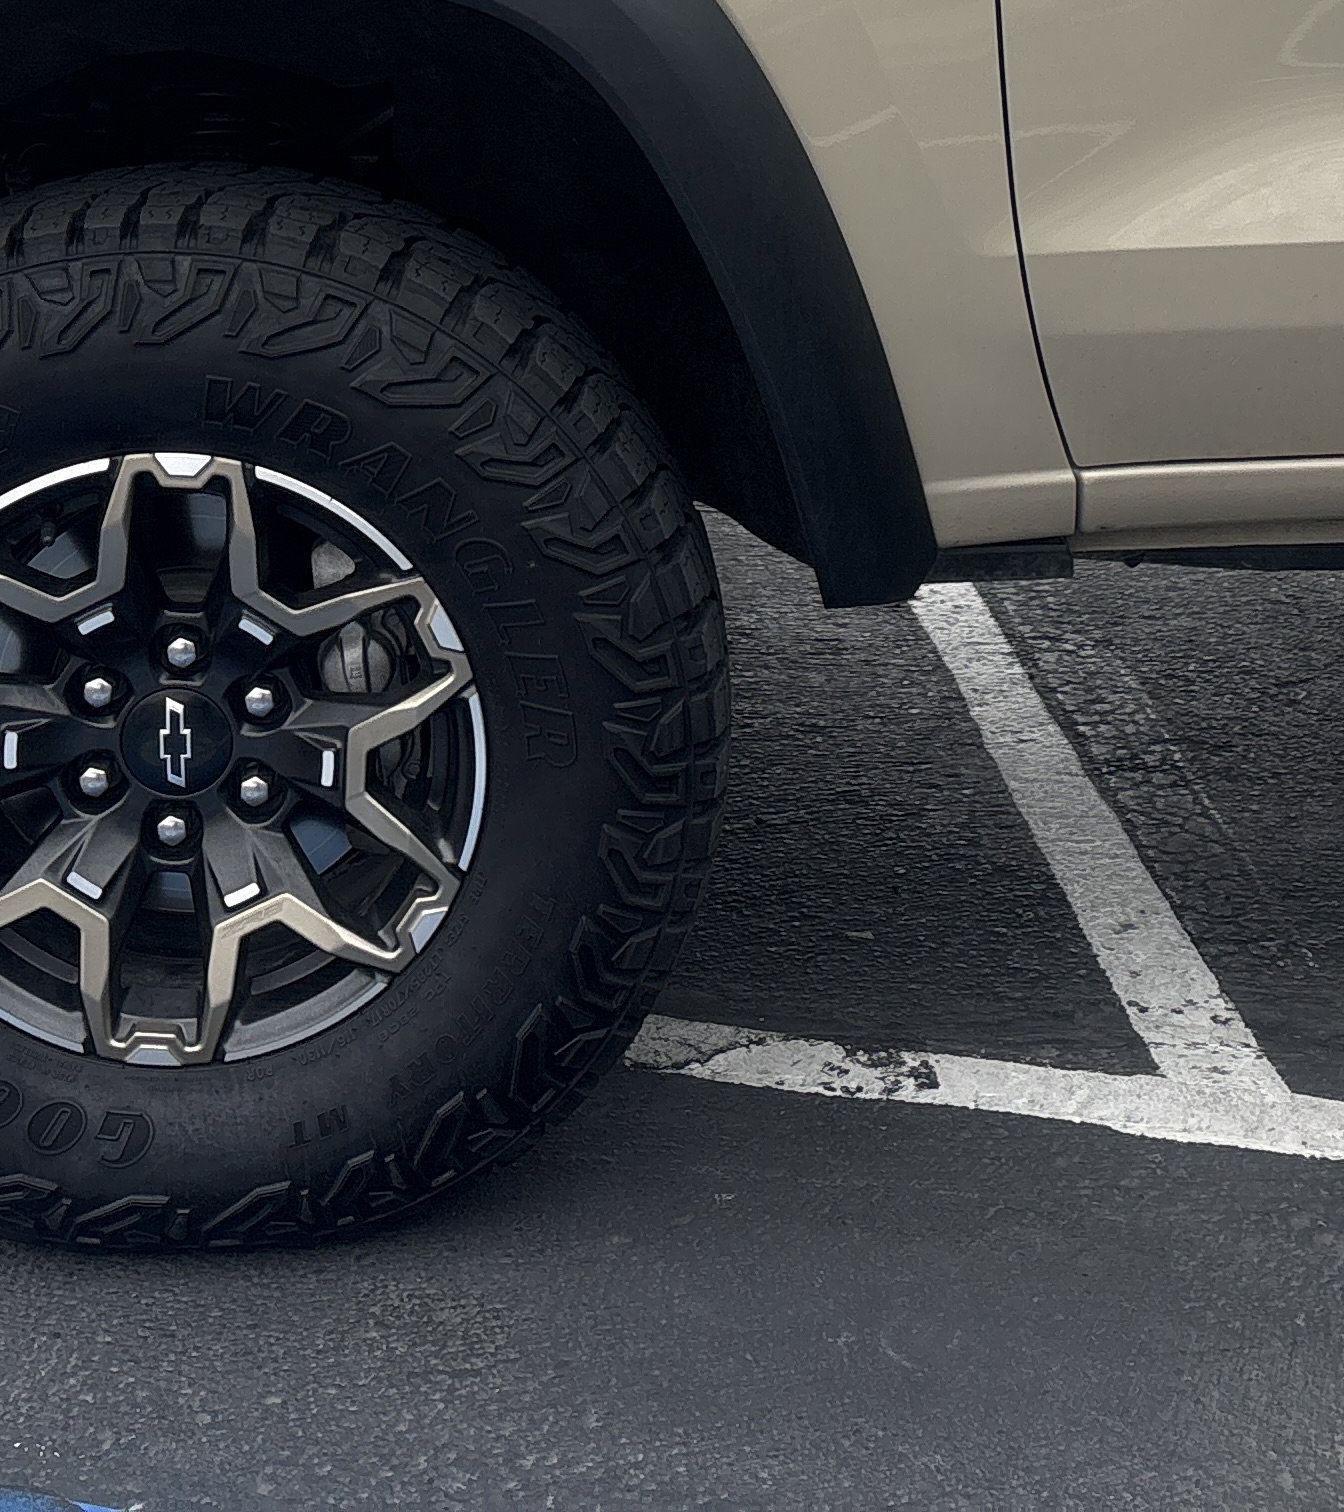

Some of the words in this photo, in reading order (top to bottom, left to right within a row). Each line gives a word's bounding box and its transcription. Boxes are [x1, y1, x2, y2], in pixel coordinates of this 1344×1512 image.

[203, 374, 578, 768] WRANGLER
[387, 891, 557, 1109] TERRITORY
[288, 1104, 349, 1149] MT
